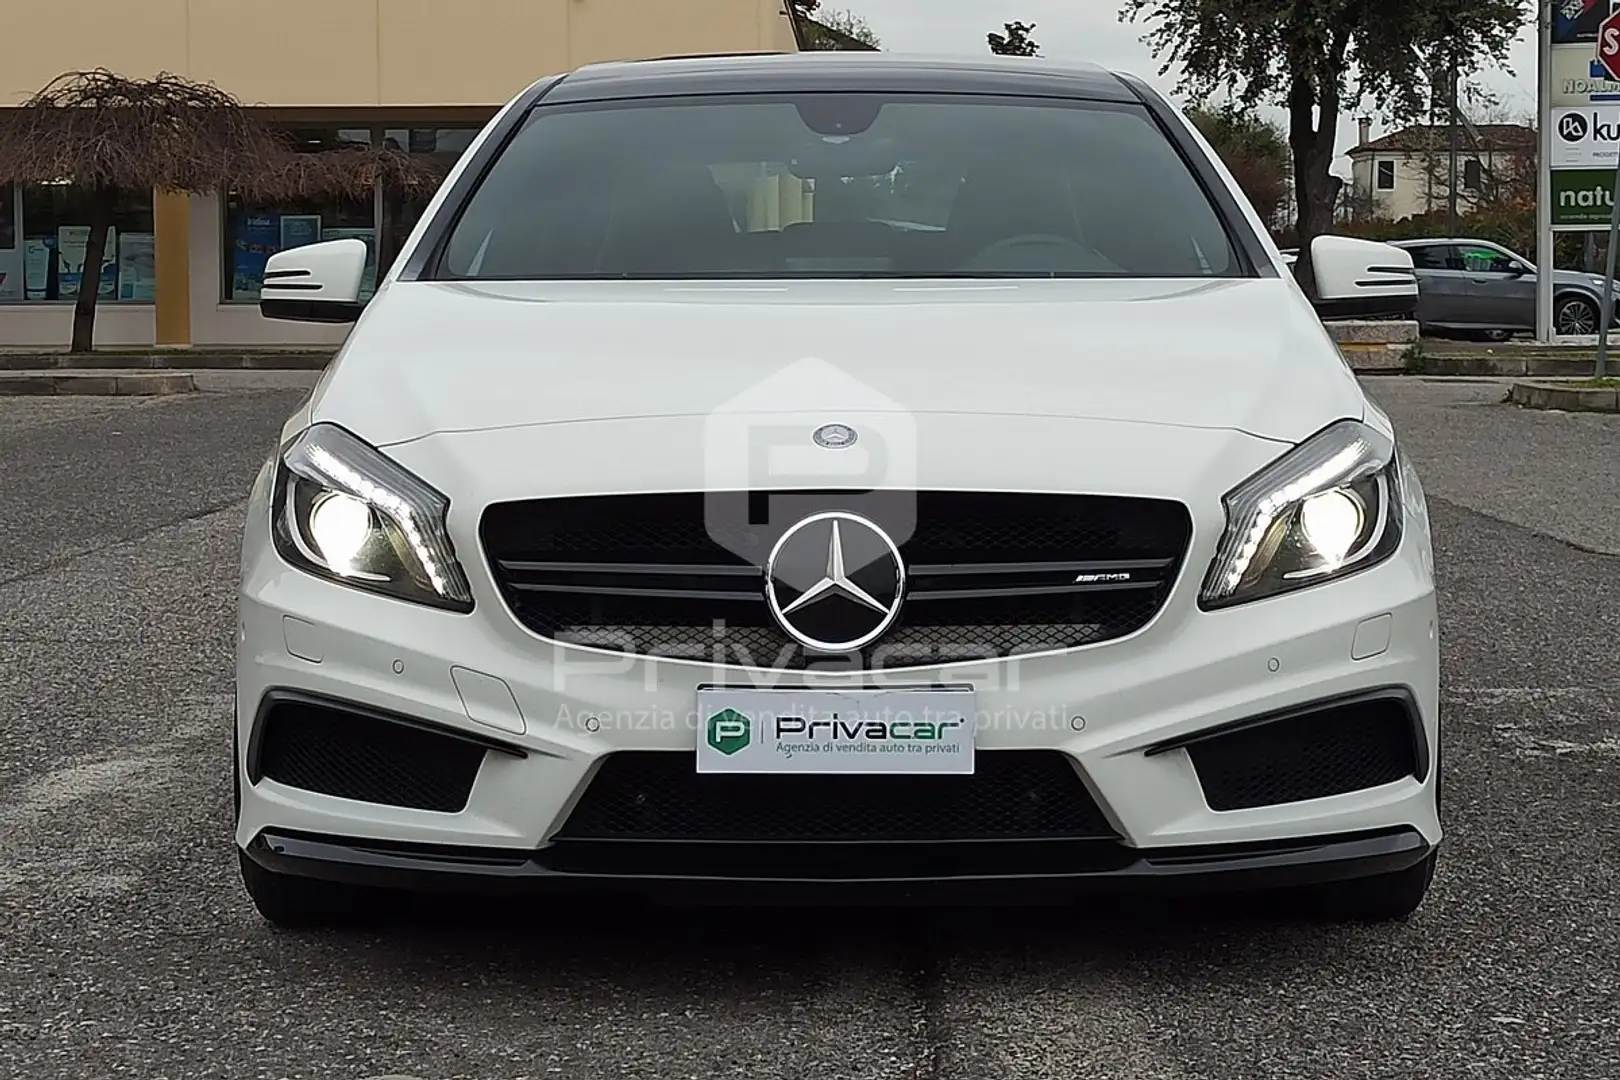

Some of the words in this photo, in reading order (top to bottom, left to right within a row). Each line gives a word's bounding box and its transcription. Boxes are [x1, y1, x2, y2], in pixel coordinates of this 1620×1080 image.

[776, 713, 961, 740] Privacar
[776, 742, 820, 757] Agenzia
[822, 742, 833, 753] di
[835, 742, 877, 753] vendita
[879, 743, 905, 753] auto
[907, 743, 923, 753] tra
[925, 742, 961, 755] privati
